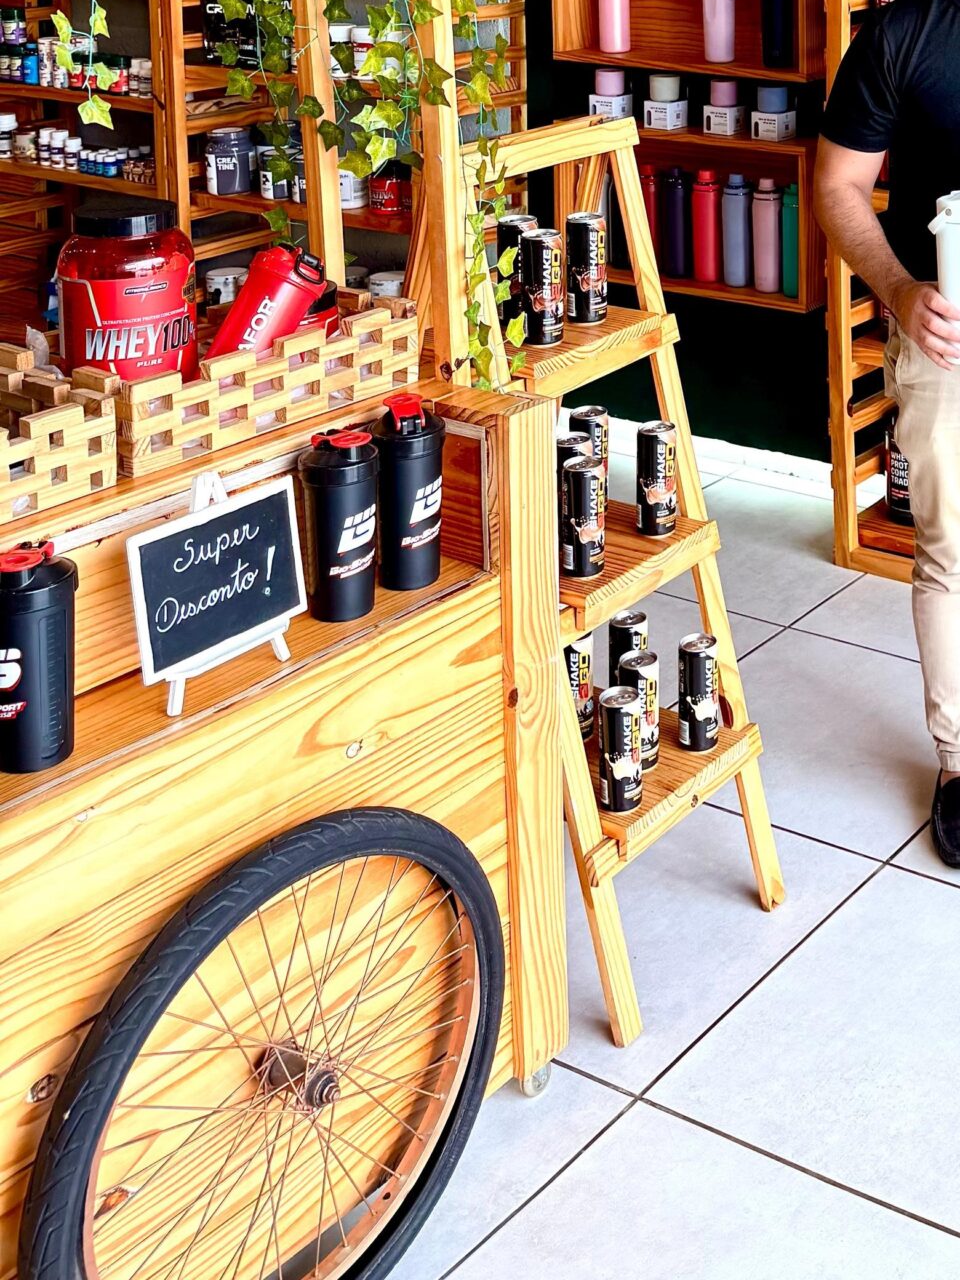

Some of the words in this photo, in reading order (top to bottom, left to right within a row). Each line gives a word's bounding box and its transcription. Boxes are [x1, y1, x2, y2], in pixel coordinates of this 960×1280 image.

[542, 249, 552, 298] SHAKE
[589, 231, 598, 280] SHAKE
[137, 358, 163, 367] PURE
[891, 460, 908, 469] PROT
[891, 467, 908, 478] CONC
[891, 475, 909, 486] TRAD
[173, 522, 260, 573] Super
[155, 558, 259, 633] Desconto
[570, 653, 579, 699] SHAKE
[705, 659, 713, 700] HAKE
[623, 716, 632, 760] HAKE
